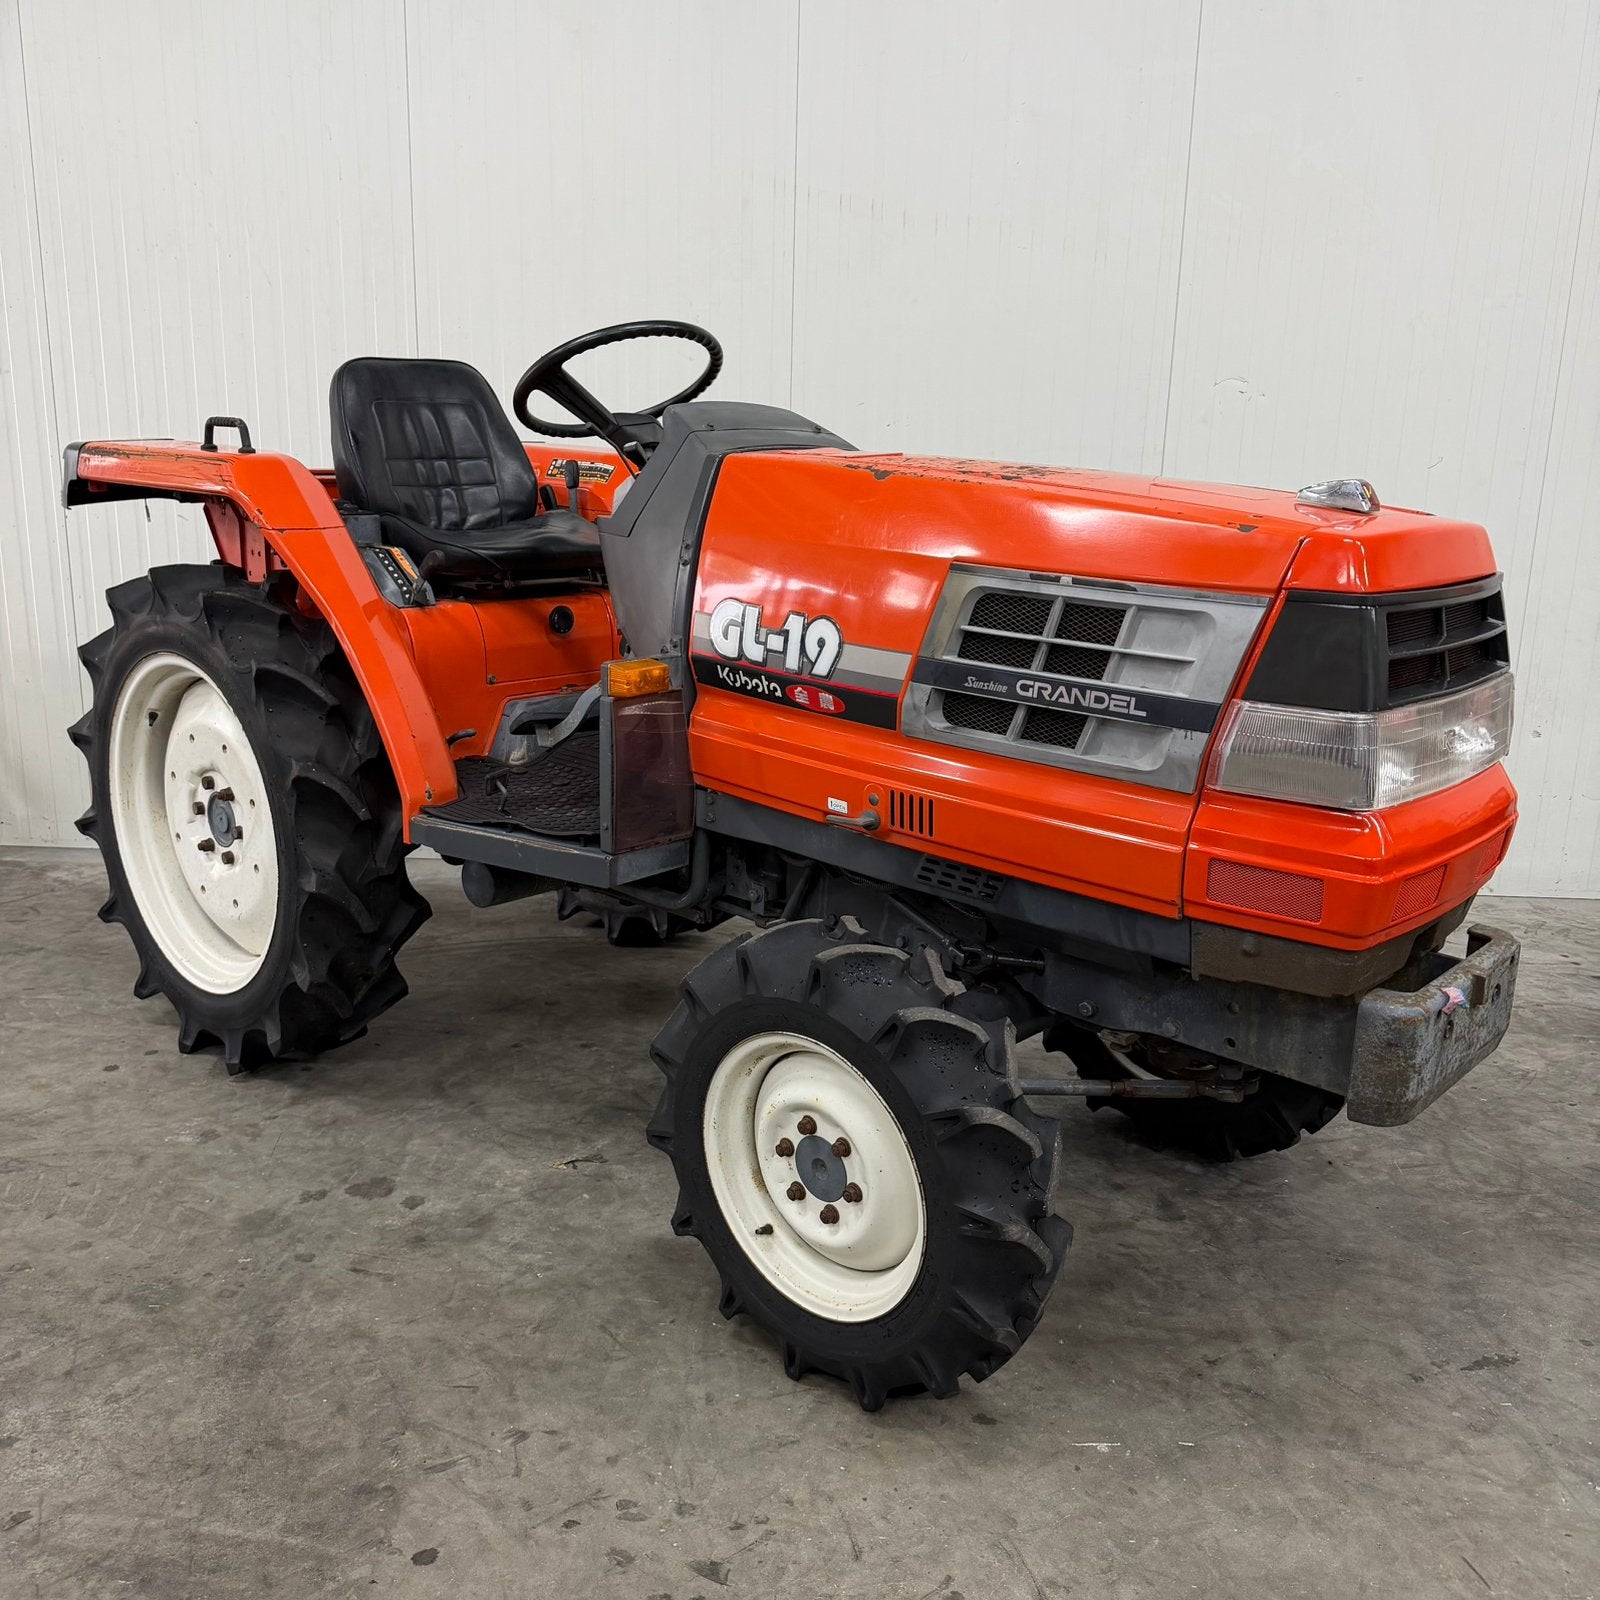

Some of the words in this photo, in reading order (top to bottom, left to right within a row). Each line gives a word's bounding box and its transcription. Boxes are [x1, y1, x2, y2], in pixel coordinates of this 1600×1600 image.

[710, 598, 842, 681] GL-19
[717, 665, 782, 698] Kubota
[963, 676, 1008, 693] Sunshine
[1016, 679, 1147, 717] GRANDEL
